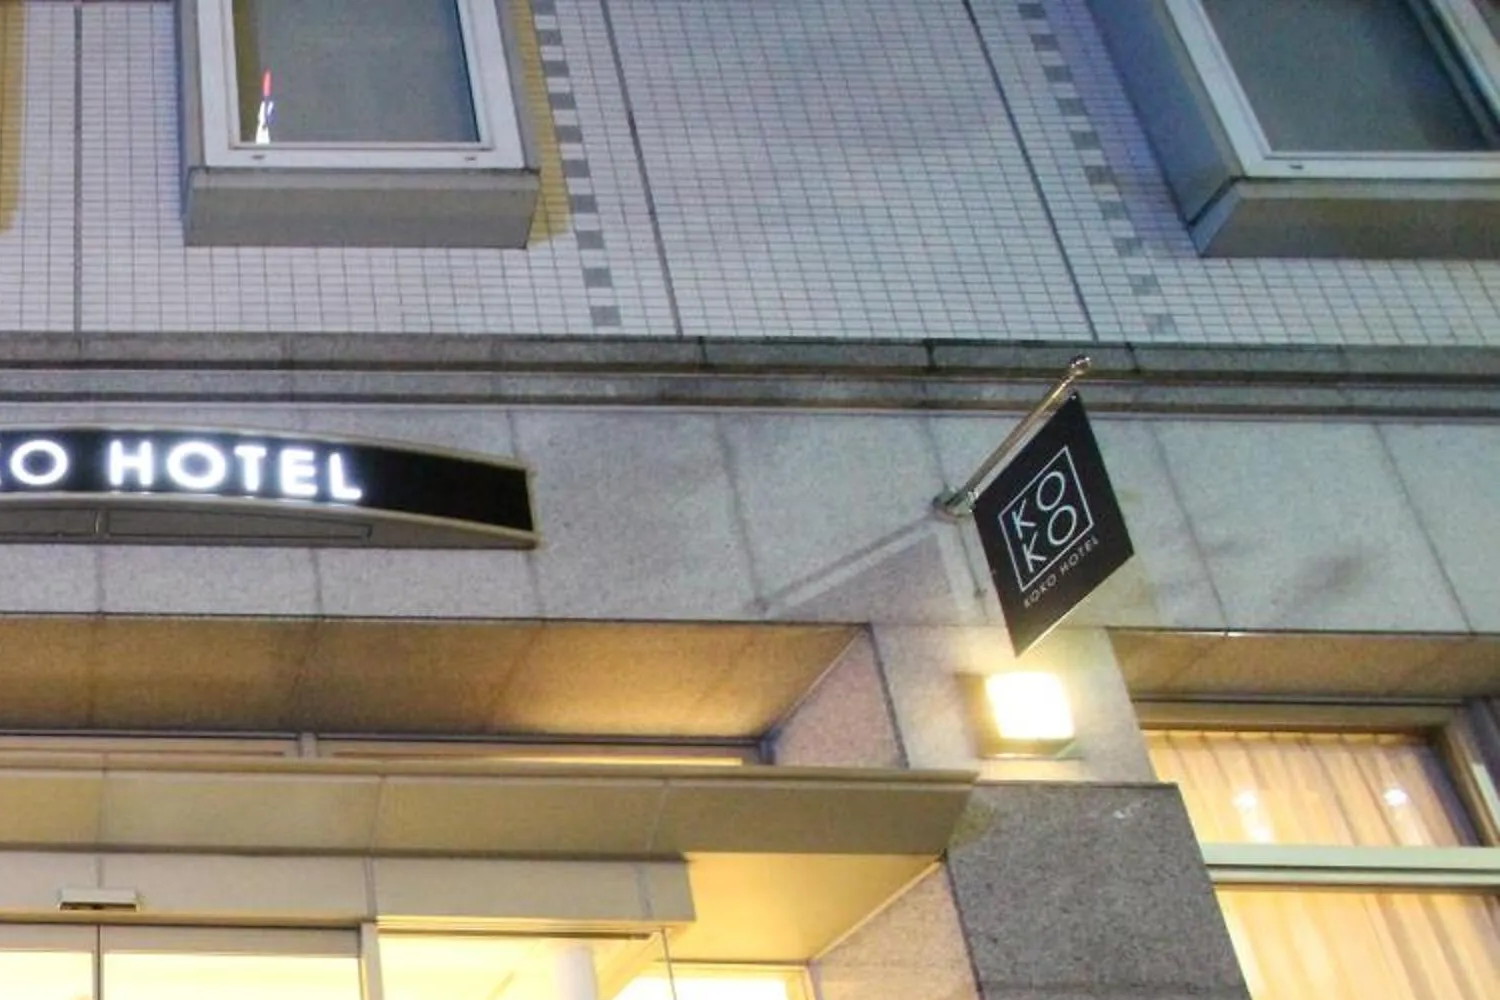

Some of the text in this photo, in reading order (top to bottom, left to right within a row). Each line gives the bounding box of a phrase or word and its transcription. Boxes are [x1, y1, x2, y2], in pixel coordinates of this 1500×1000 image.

[108, 440, 363, 500] HOTEL
[1023, 535, 1099, 608] KOKO HOTEL
